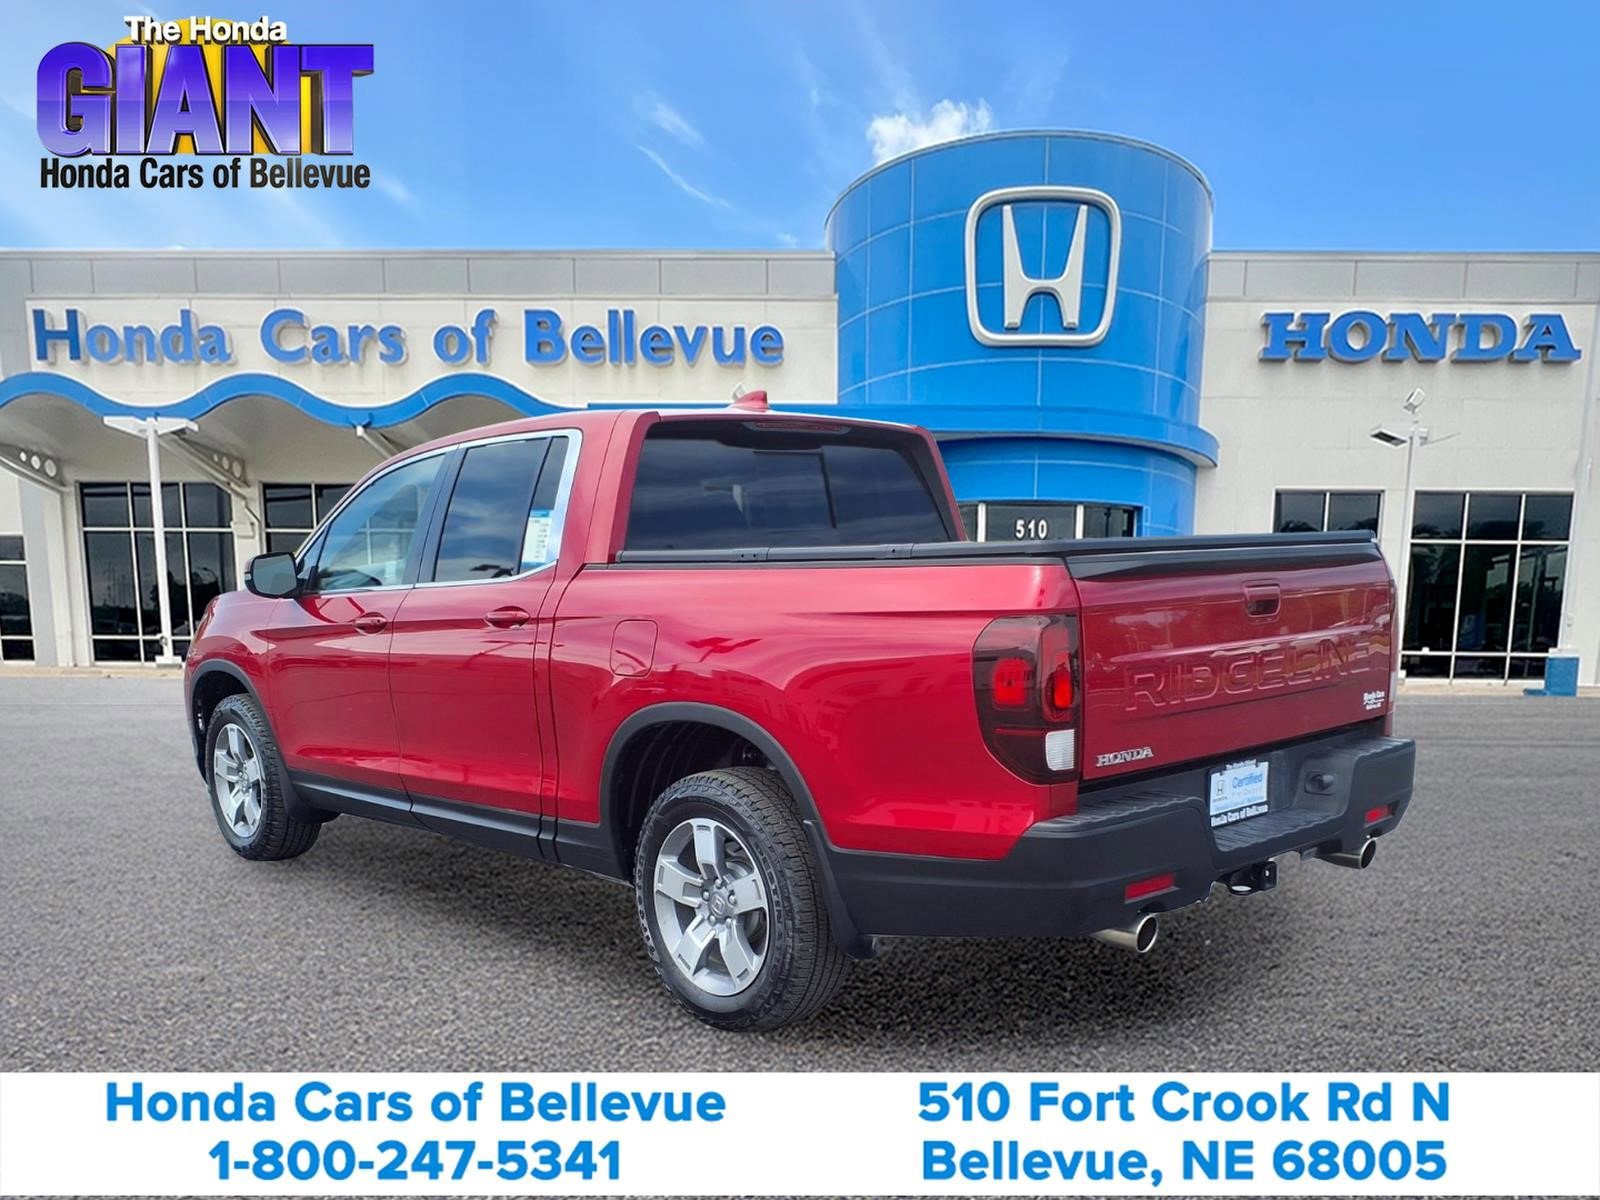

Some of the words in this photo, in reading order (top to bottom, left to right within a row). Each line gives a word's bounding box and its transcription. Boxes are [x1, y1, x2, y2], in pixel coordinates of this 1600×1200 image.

[33, 309, 232, 364] Honda
[260, 308, 405, 364] Cars
[433, 308, 497, 364] of
[523, 308, 785, 364] Bellevue
[1260, 310, 1582, 363] HONDA
[1015, 519, 1048, 540] 510
[1125, 640, 1370, 711] RIDGELINE
[1095, 746, 1154, 767] HONDA
